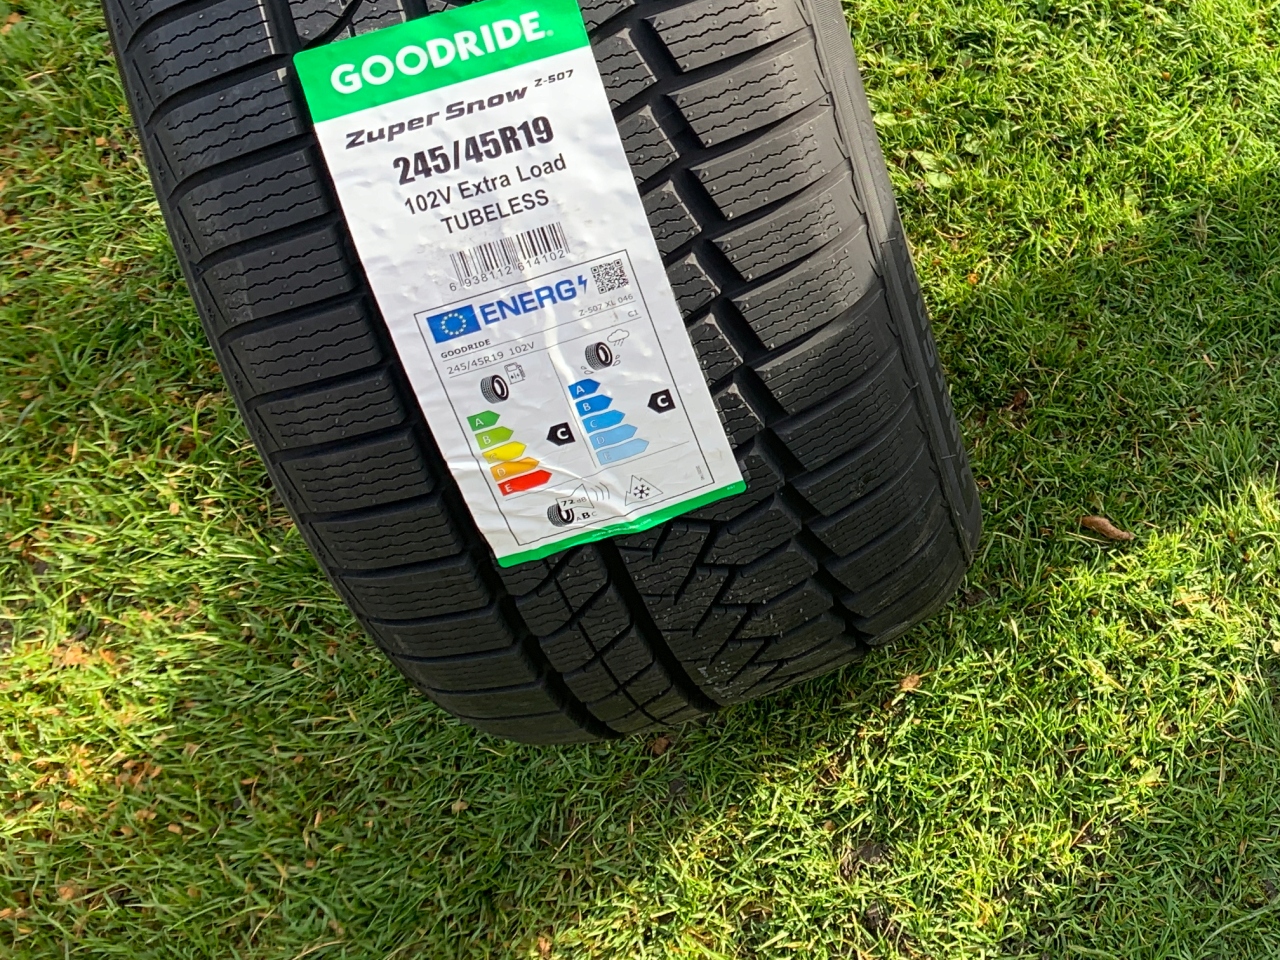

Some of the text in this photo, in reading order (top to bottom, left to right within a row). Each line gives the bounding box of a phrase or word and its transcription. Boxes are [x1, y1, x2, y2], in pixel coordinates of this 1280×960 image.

[330, 10, 546, 95] GOODRIDE
[345, 69, 574, 149] Zuper Snow Z-507
[392, 115, 555, 186] 245/45R19
[404, 153, 567, 216] 102V Extra Load
[440, 189, 550, 235] TUBELESS
[449, 249, 566, 291] 6 938112 614102
[480, 279, 577, 325] ENERG
[578, 293, 634, 317] Z-507 XL 046
[627, 309, 639, 318] C1
[440, 339, 491, 359] GOODRIDE
[447, 341, 535, 375] 245/45R19 102V
[576, 385, 585, 395] A
[583, 402, 591, 411] B
[657, 395, 669, 407] C
[475, 418, 484, 427] A
[590, 420, 597, 428] C
[557, 427, 569, 439] C
[482, 435, 491, 445] B
[497, 468, 506, 477] D
[505, 484, 513, 493] E
[560, 496, 588, 507] 72 dB
[582, 511, 591, 520] B
